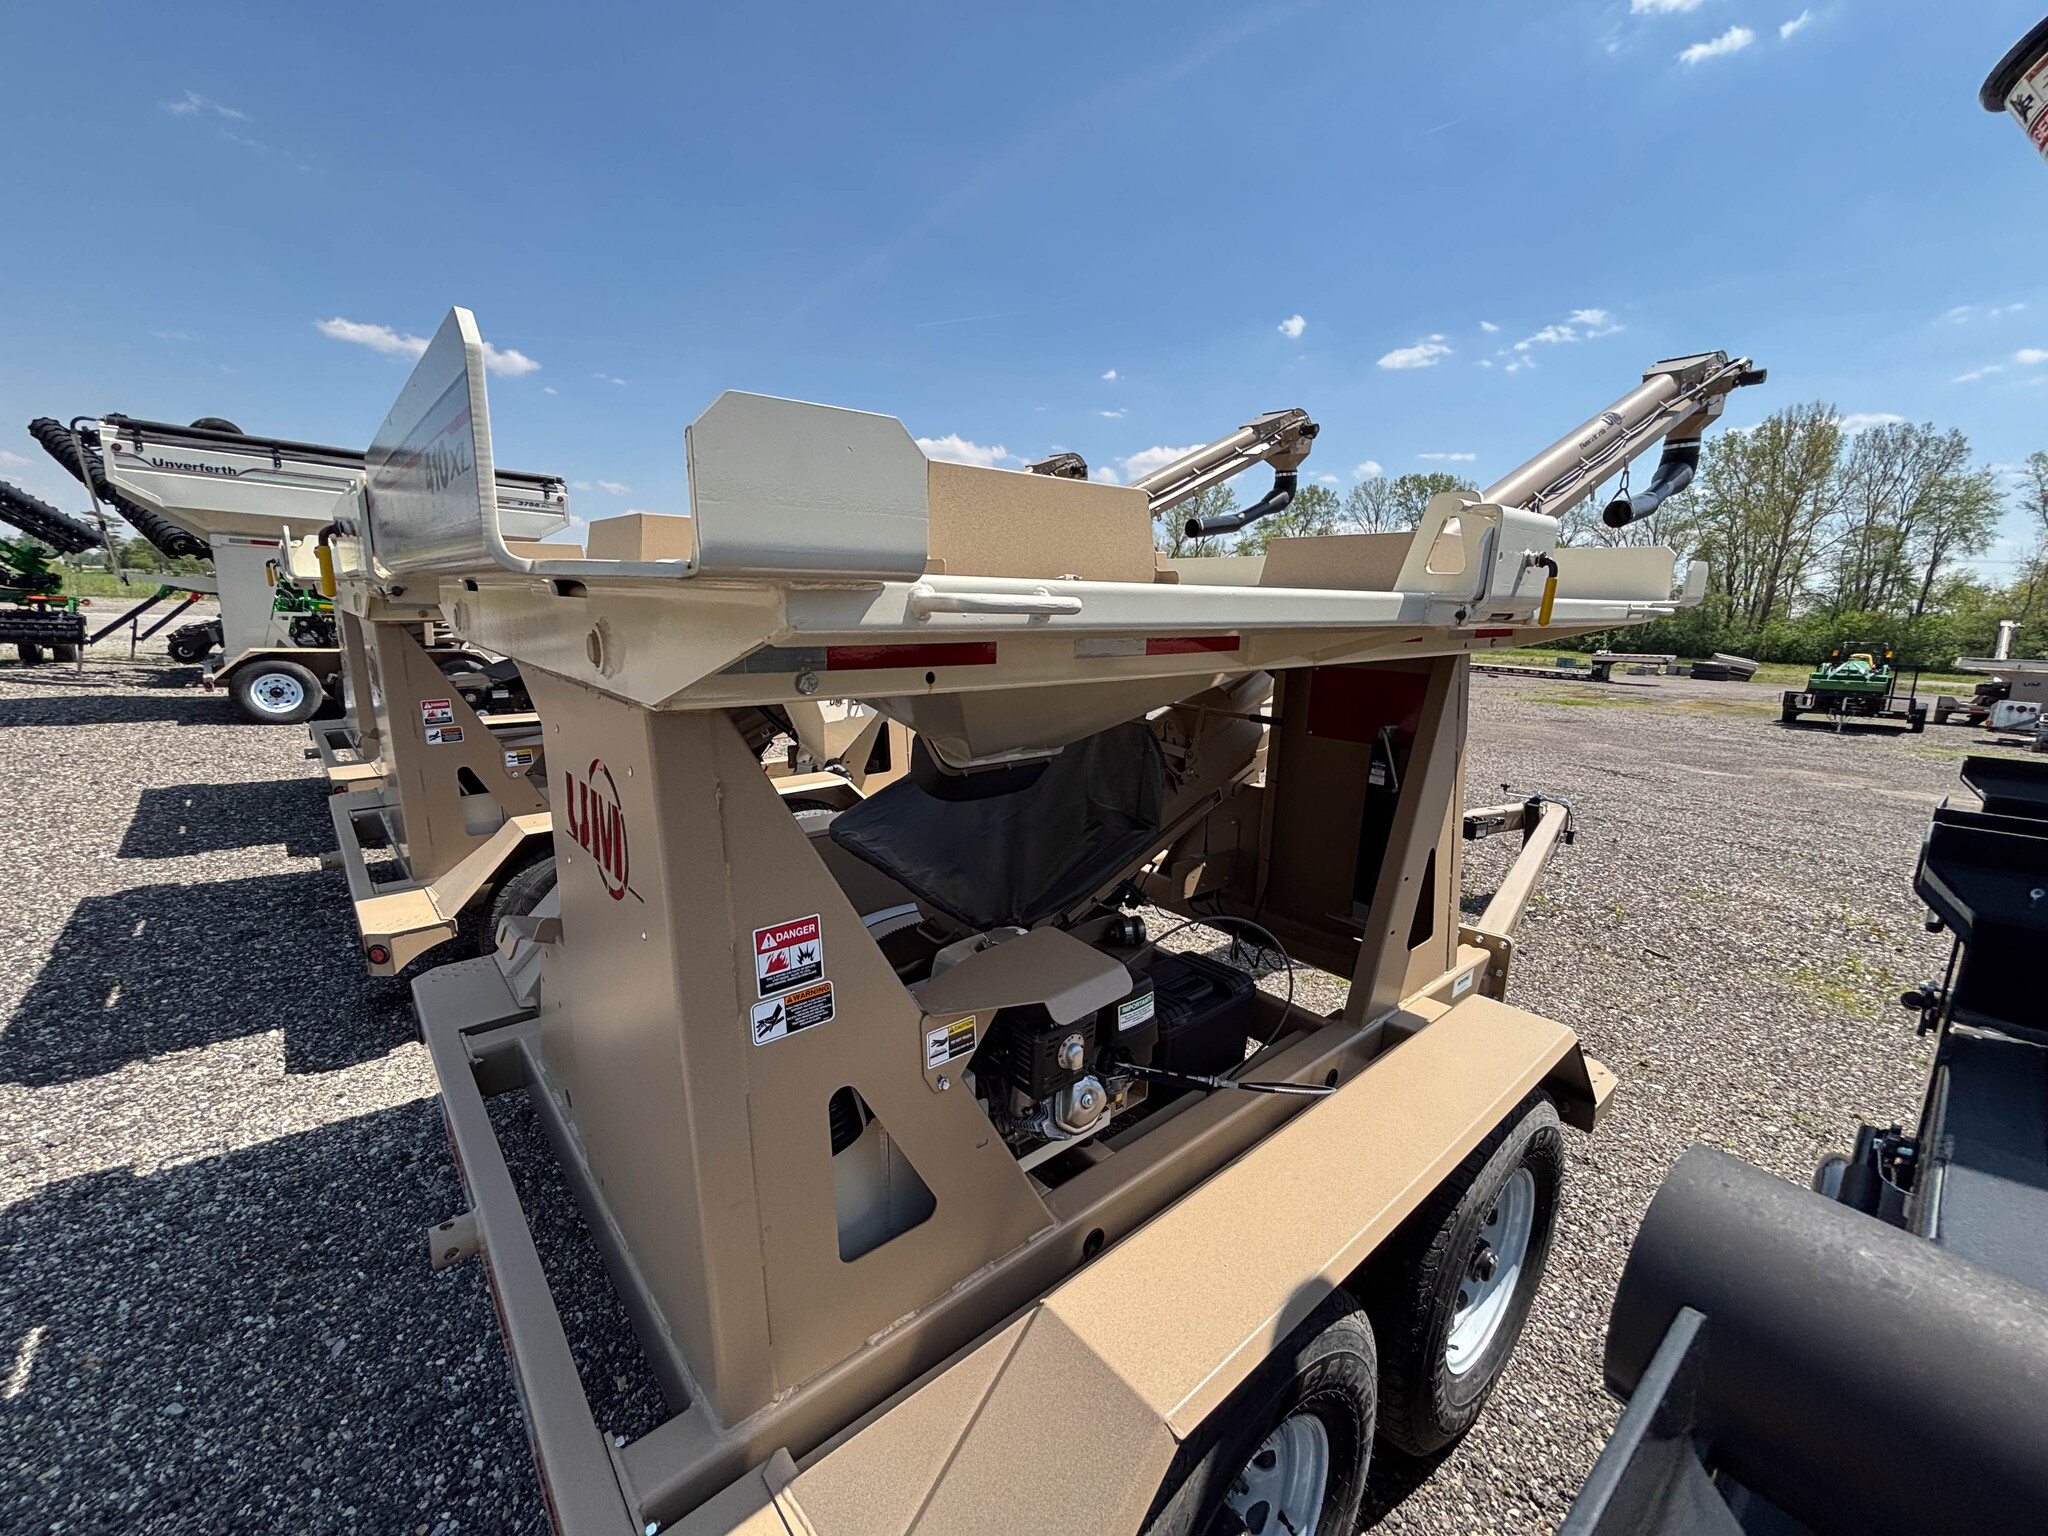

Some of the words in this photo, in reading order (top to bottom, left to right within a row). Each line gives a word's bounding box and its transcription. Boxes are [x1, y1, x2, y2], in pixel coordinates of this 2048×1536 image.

[152, 457, 237, 476] Unverferth
[775, 923, 816, 942] DANGER
[792, 984, 830, 1002] WARNING
